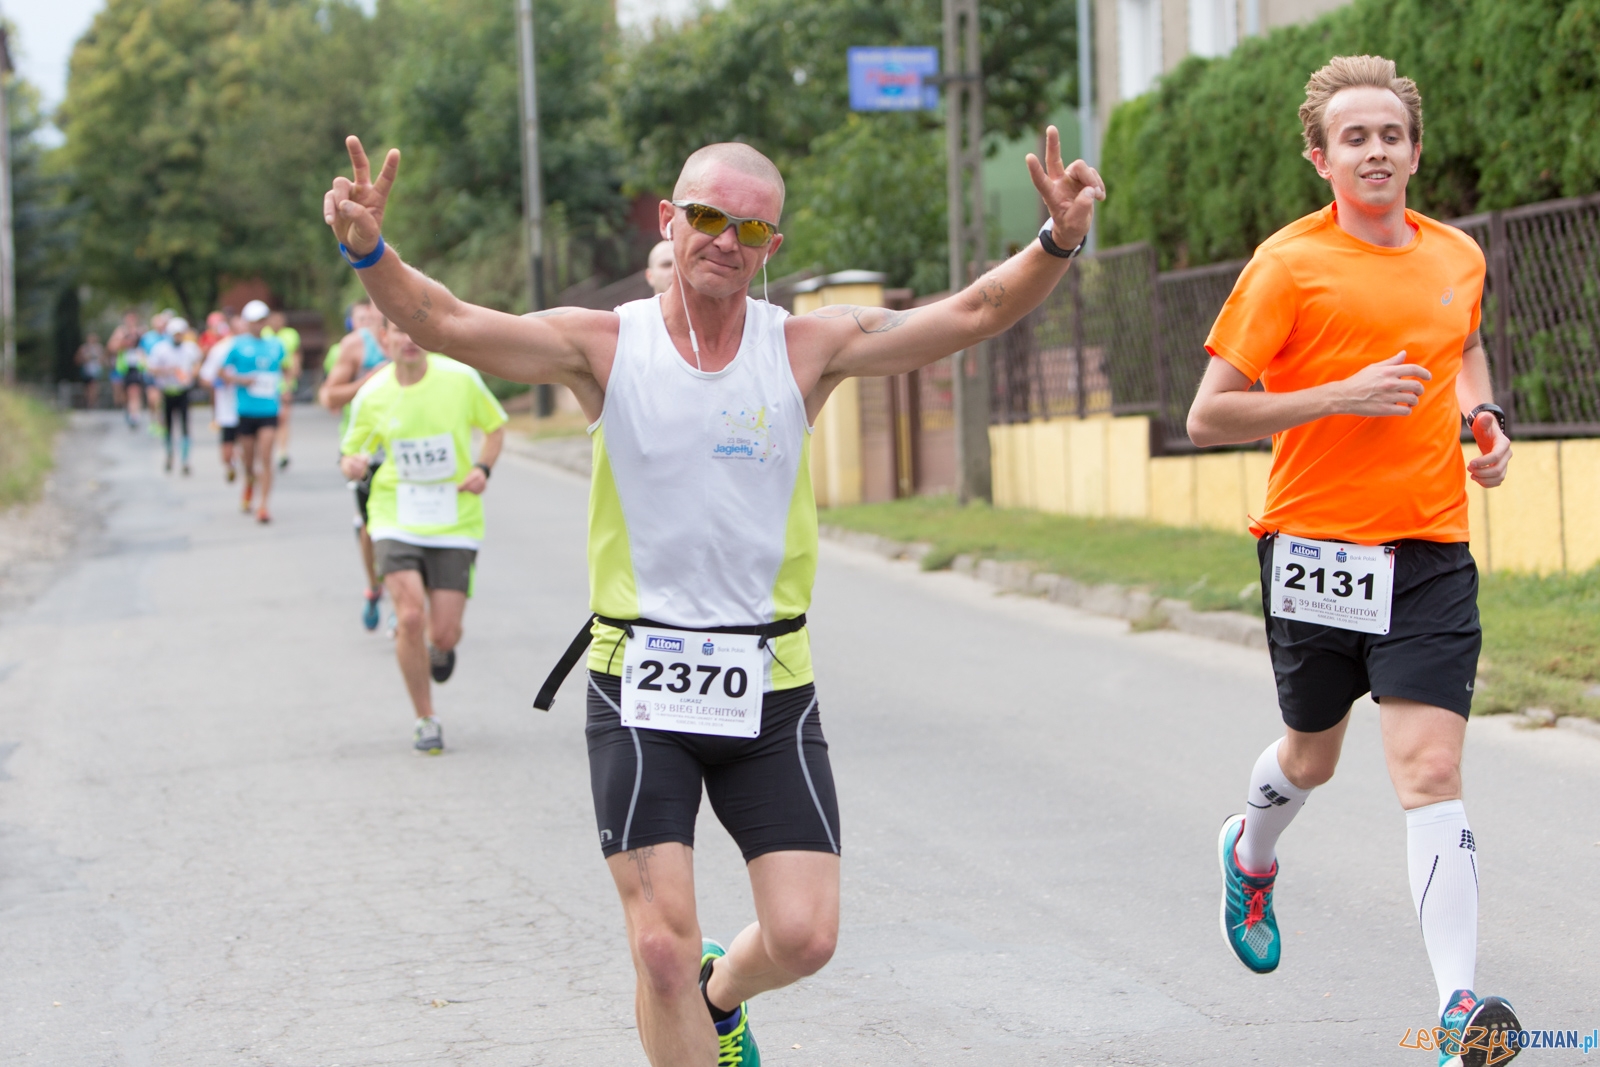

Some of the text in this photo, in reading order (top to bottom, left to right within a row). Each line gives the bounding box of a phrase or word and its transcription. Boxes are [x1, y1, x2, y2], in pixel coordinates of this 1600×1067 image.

[402, 448, 447, 464] 1152
[1284, 563, 1374, 600] 2131
[1298, 598, 1310, 608] 39
[1312, 600, 1332, 611] BIEG
[1334, 603, 1379, 618] LECHITÓW
[637, 660, 748, 698] 2370
[653, 702, 666, 712] 39
[669, 704, 693, 714] BIEG
[696, 705, 748, 718] LECHITÓW
